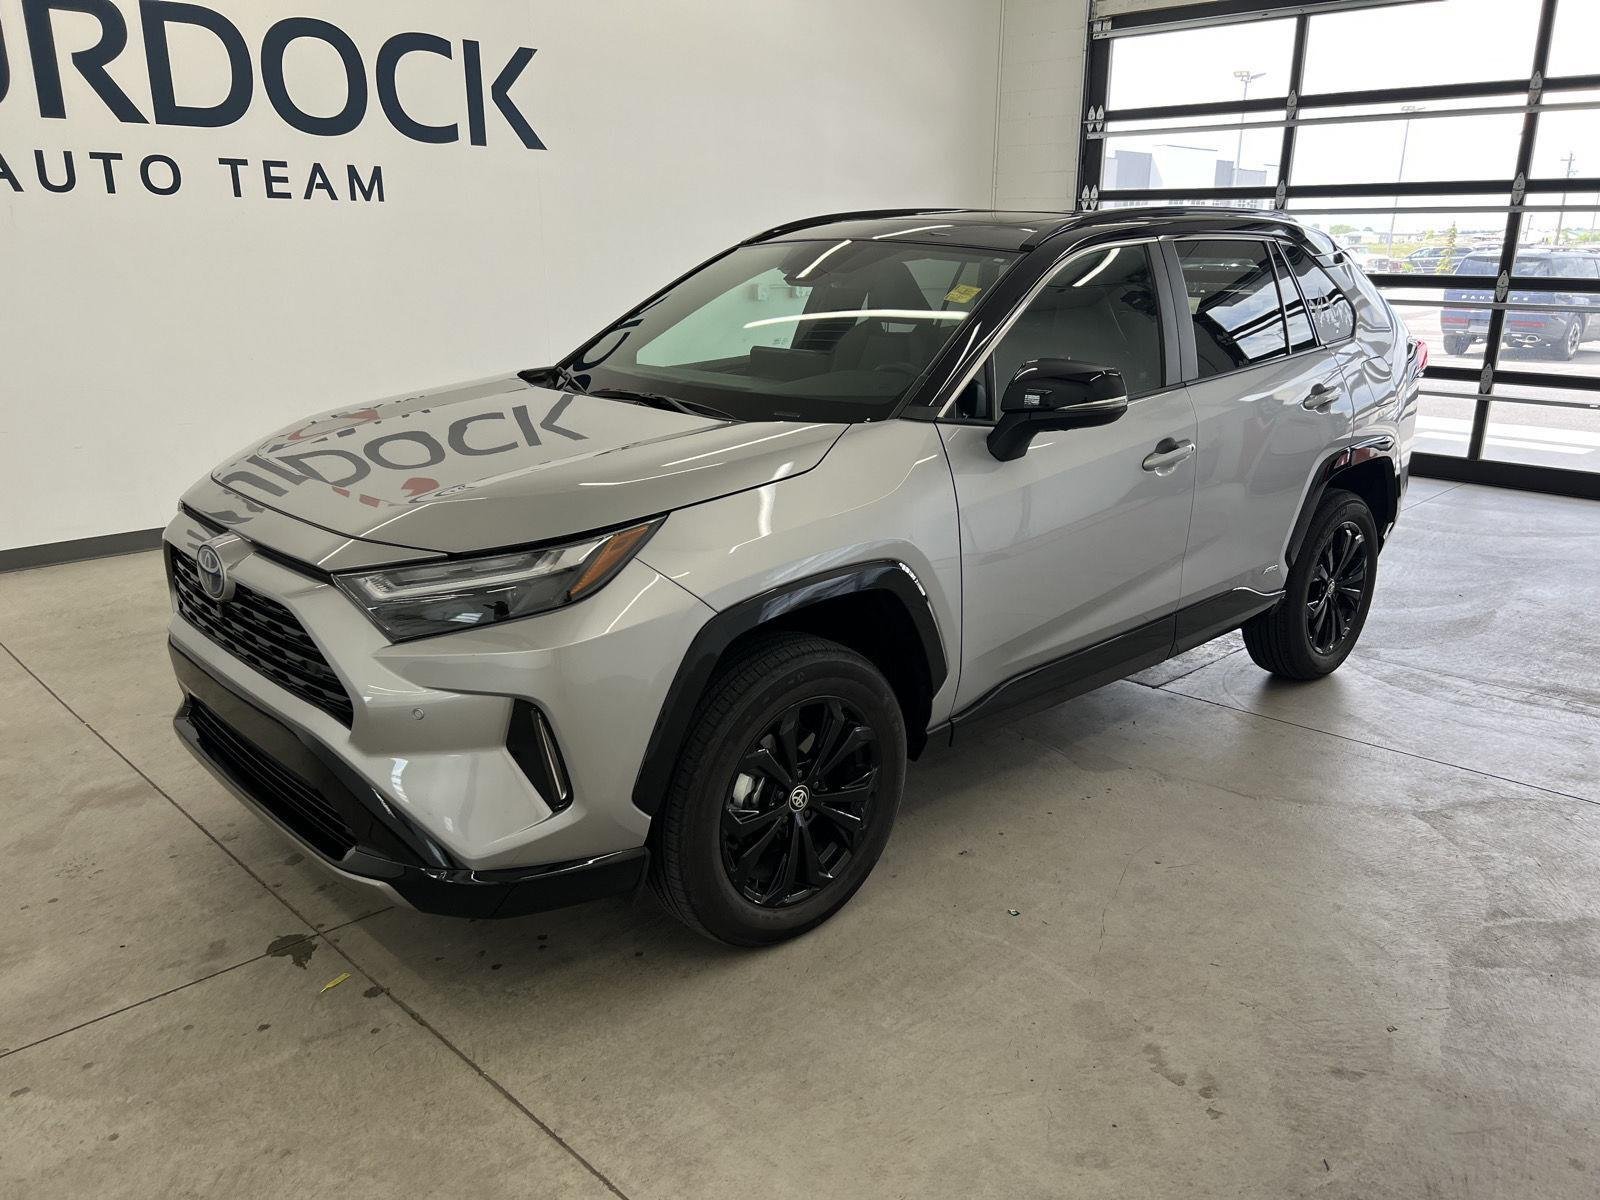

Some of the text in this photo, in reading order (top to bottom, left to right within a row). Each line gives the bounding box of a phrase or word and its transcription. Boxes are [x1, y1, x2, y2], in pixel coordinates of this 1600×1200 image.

[0, 0, 548, 151] RDOCK
[0, 149, 386, 203] AUTO TEAM
